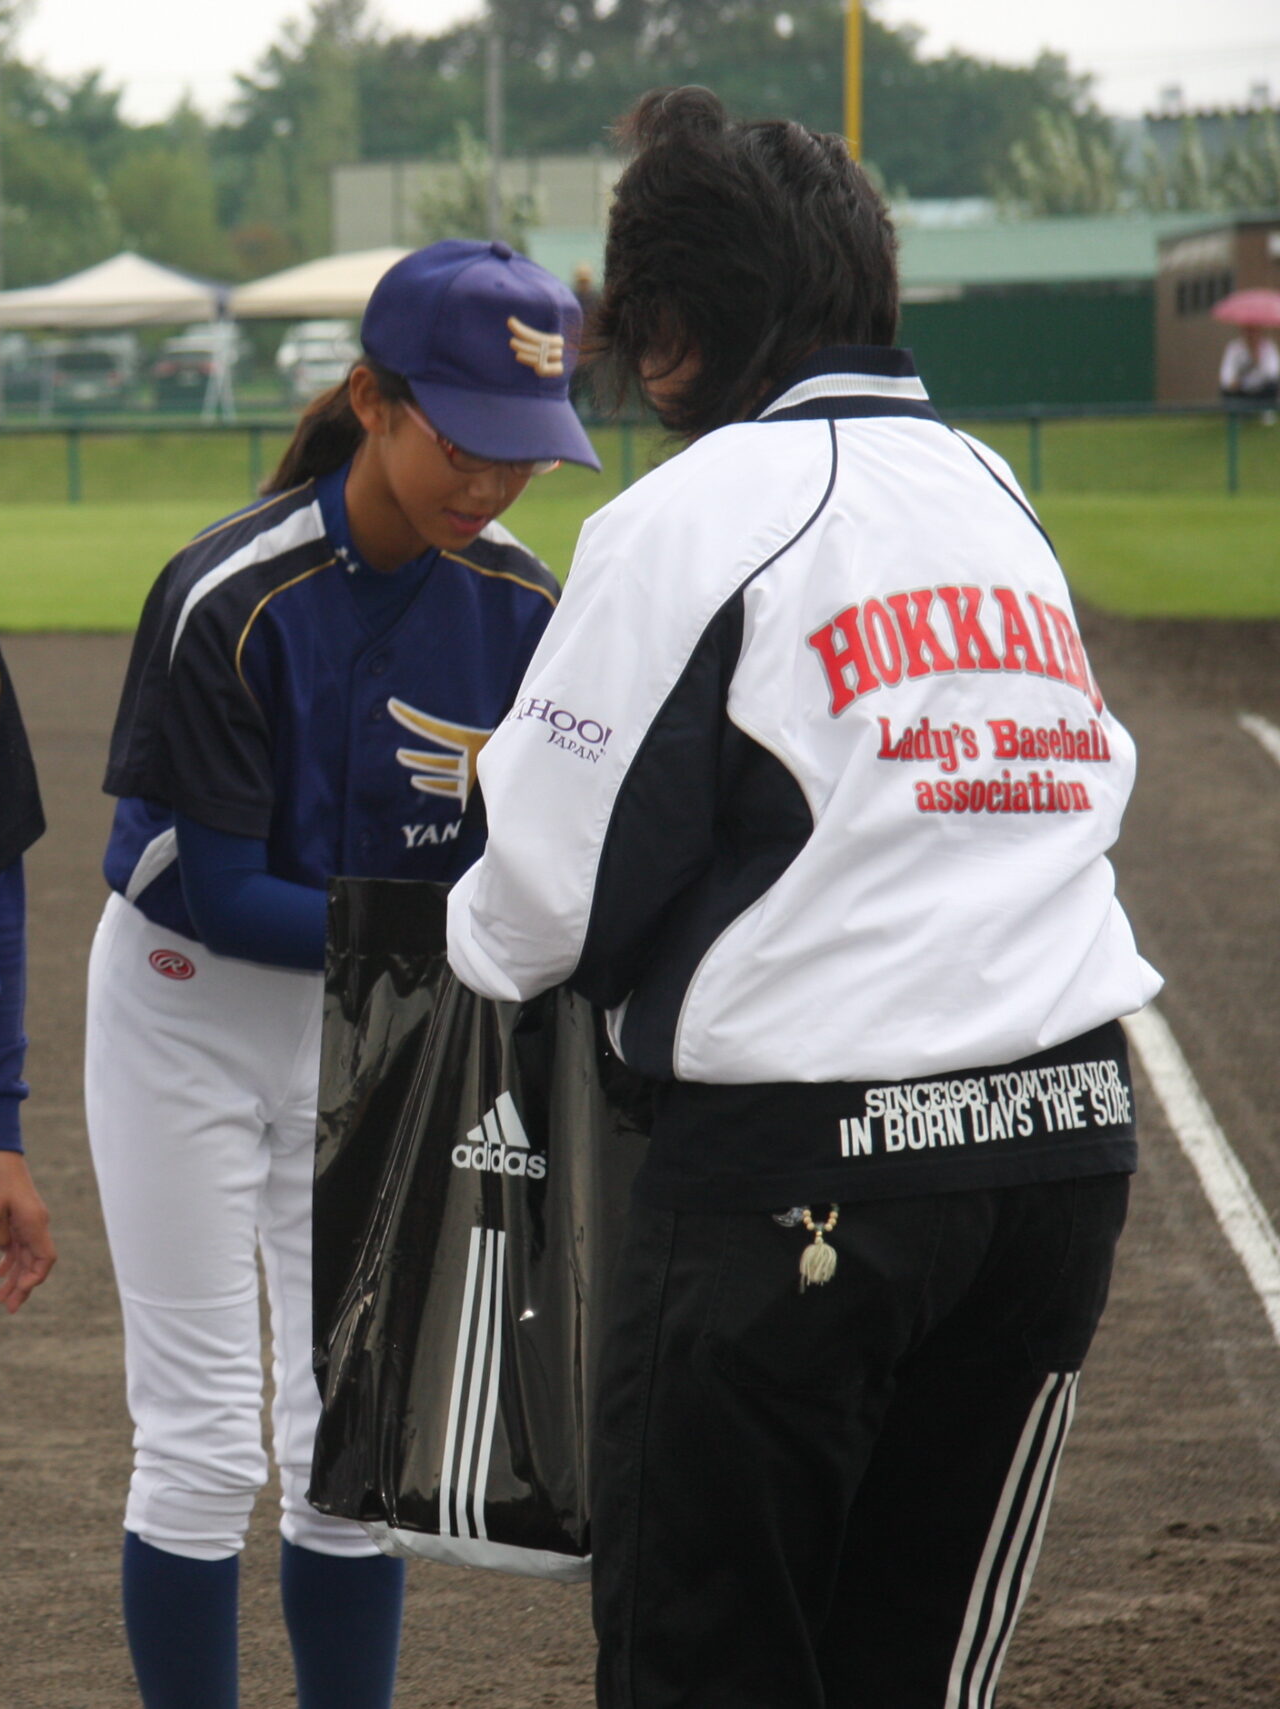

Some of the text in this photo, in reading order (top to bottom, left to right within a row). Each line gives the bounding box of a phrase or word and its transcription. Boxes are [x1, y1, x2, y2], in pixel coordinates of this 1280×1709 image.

[806, 583, 1106, 719] HOKKAID
[546, 729, 600, 764] JAPAN
[876, 716, 1112, 774] Lady's Baseball
[914, 769, 1094, 814] association
[839, 1117, 873, 1158] IN
[884, 1105, 966, 1153] BORN
[970, 1099, 1034, 1143] DAYS
[1039, 1090, 1087, 1132] THE
[451, 1142, 547, 1179] adidas
